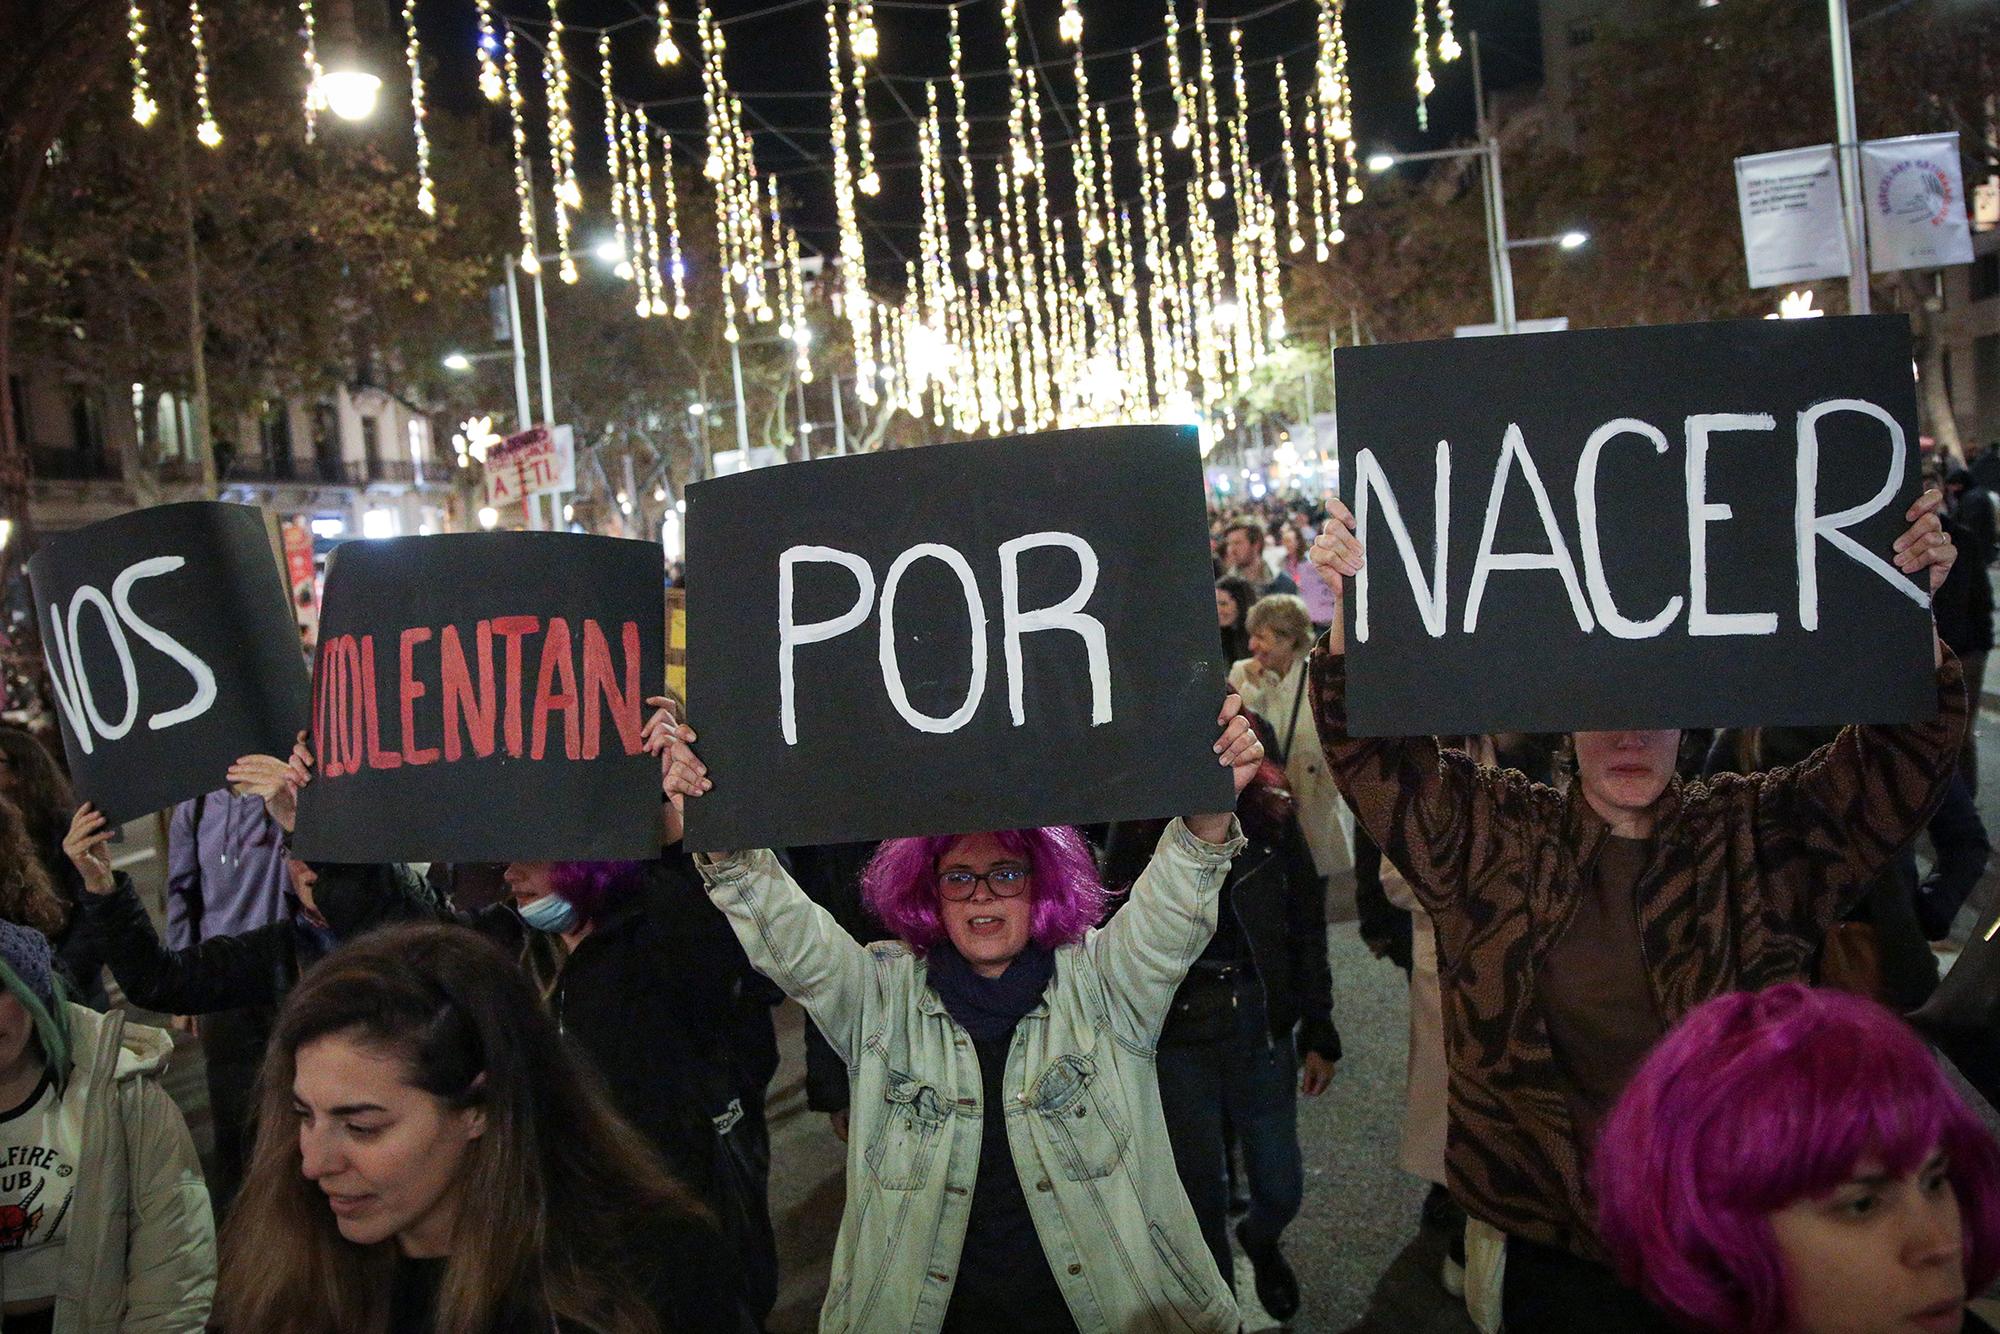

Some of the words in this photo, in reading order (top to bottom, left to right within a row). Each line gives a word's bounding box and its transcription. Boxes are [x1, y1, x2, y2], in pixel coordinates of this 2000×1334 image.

[1355, 398, 1930, 644] NACER
[42, 555, 218, 756] NOS
[312, 614, 642, 778] VIOLENTAN
[778, 531, 1113, 746] POR
